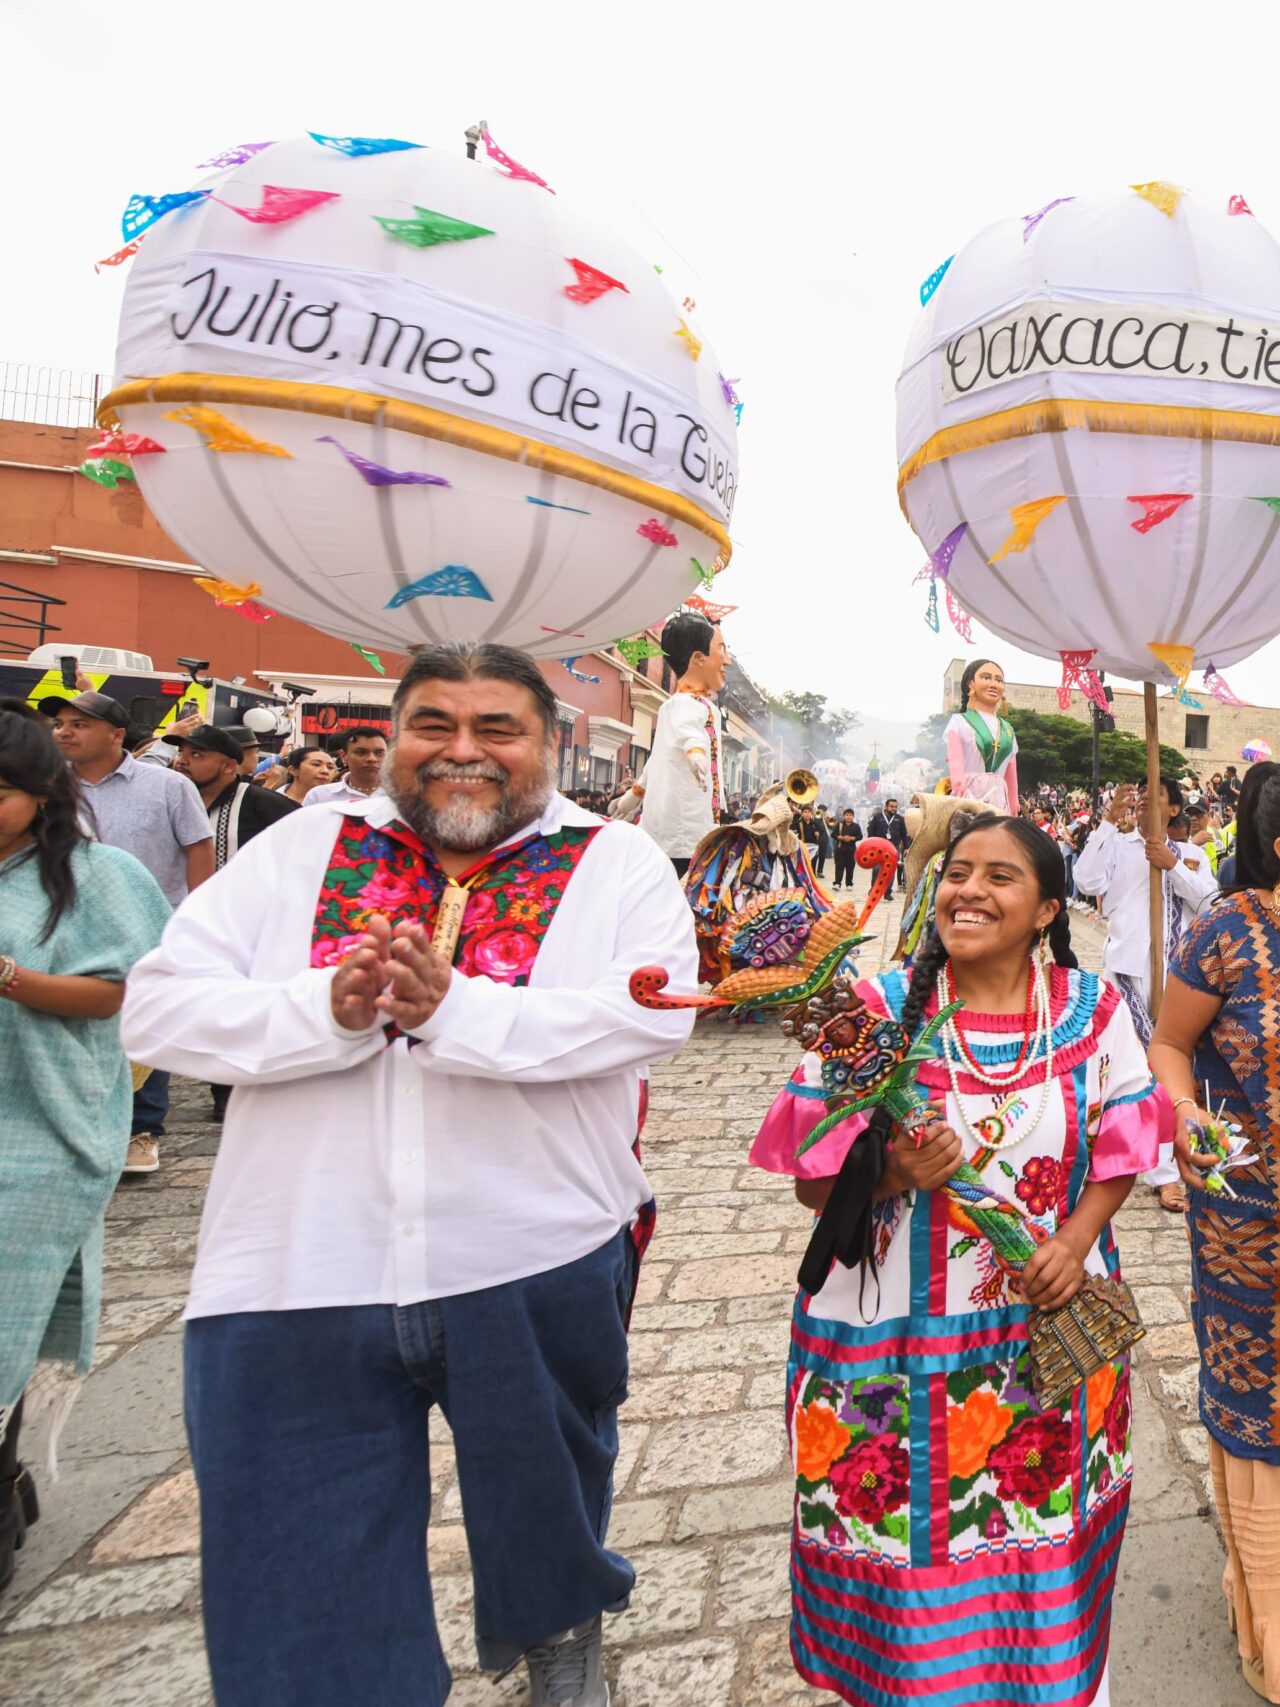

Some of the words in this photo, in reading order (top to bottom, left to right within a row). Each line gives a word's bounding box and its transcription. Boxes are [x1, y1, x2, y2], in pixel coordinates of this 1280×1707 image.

[171, 267, 340, 360] Julio,
[360, 311, 496, 397] mes
[529, 368, 600, 431] de
[618, 391, 656, 458] la
[946, 312, 1209, 393] Oaxaca,
